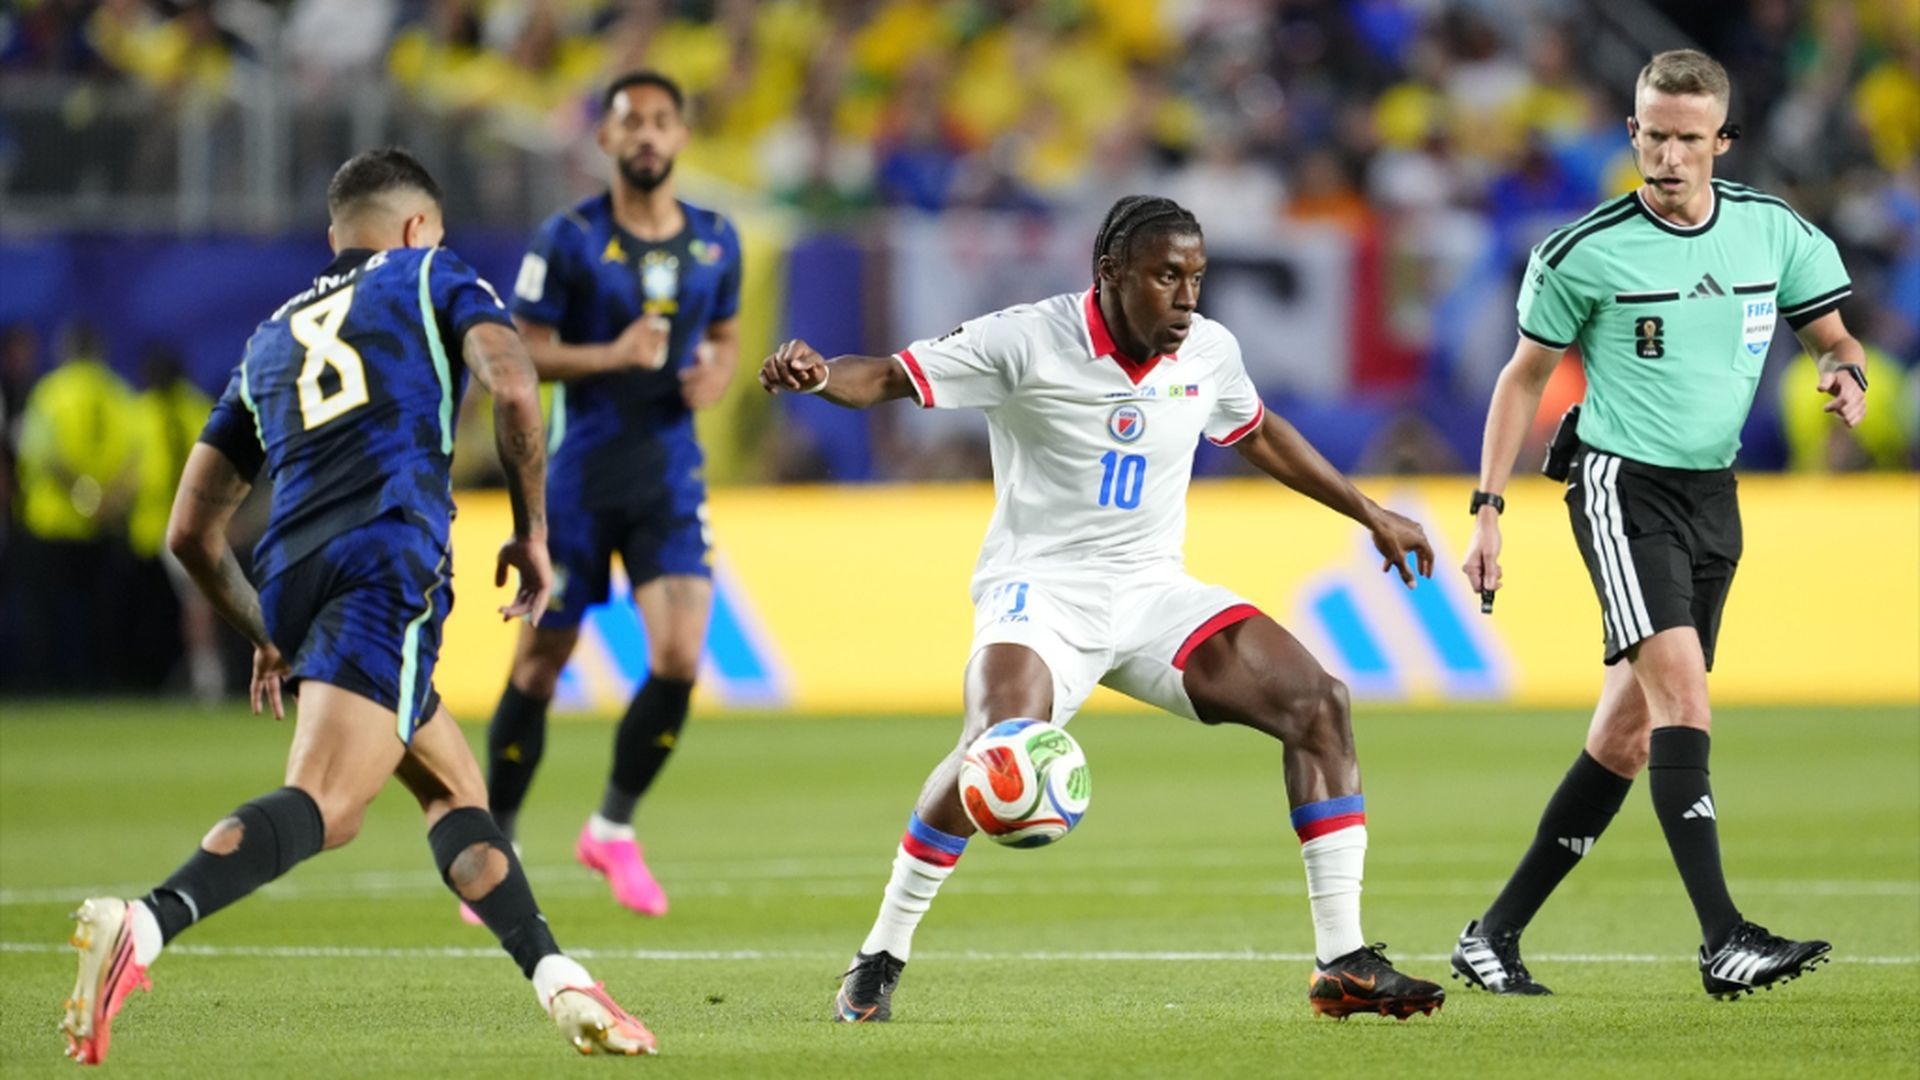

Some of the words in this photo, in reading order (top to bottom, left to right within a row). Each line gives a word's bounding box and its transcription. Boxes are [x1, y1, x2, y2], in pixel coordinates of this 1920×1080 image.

[1747, 301, 1774, 317] FIFA
[290, 284, 369, 431] 8
[1099, 450, 1146, 510] 10
